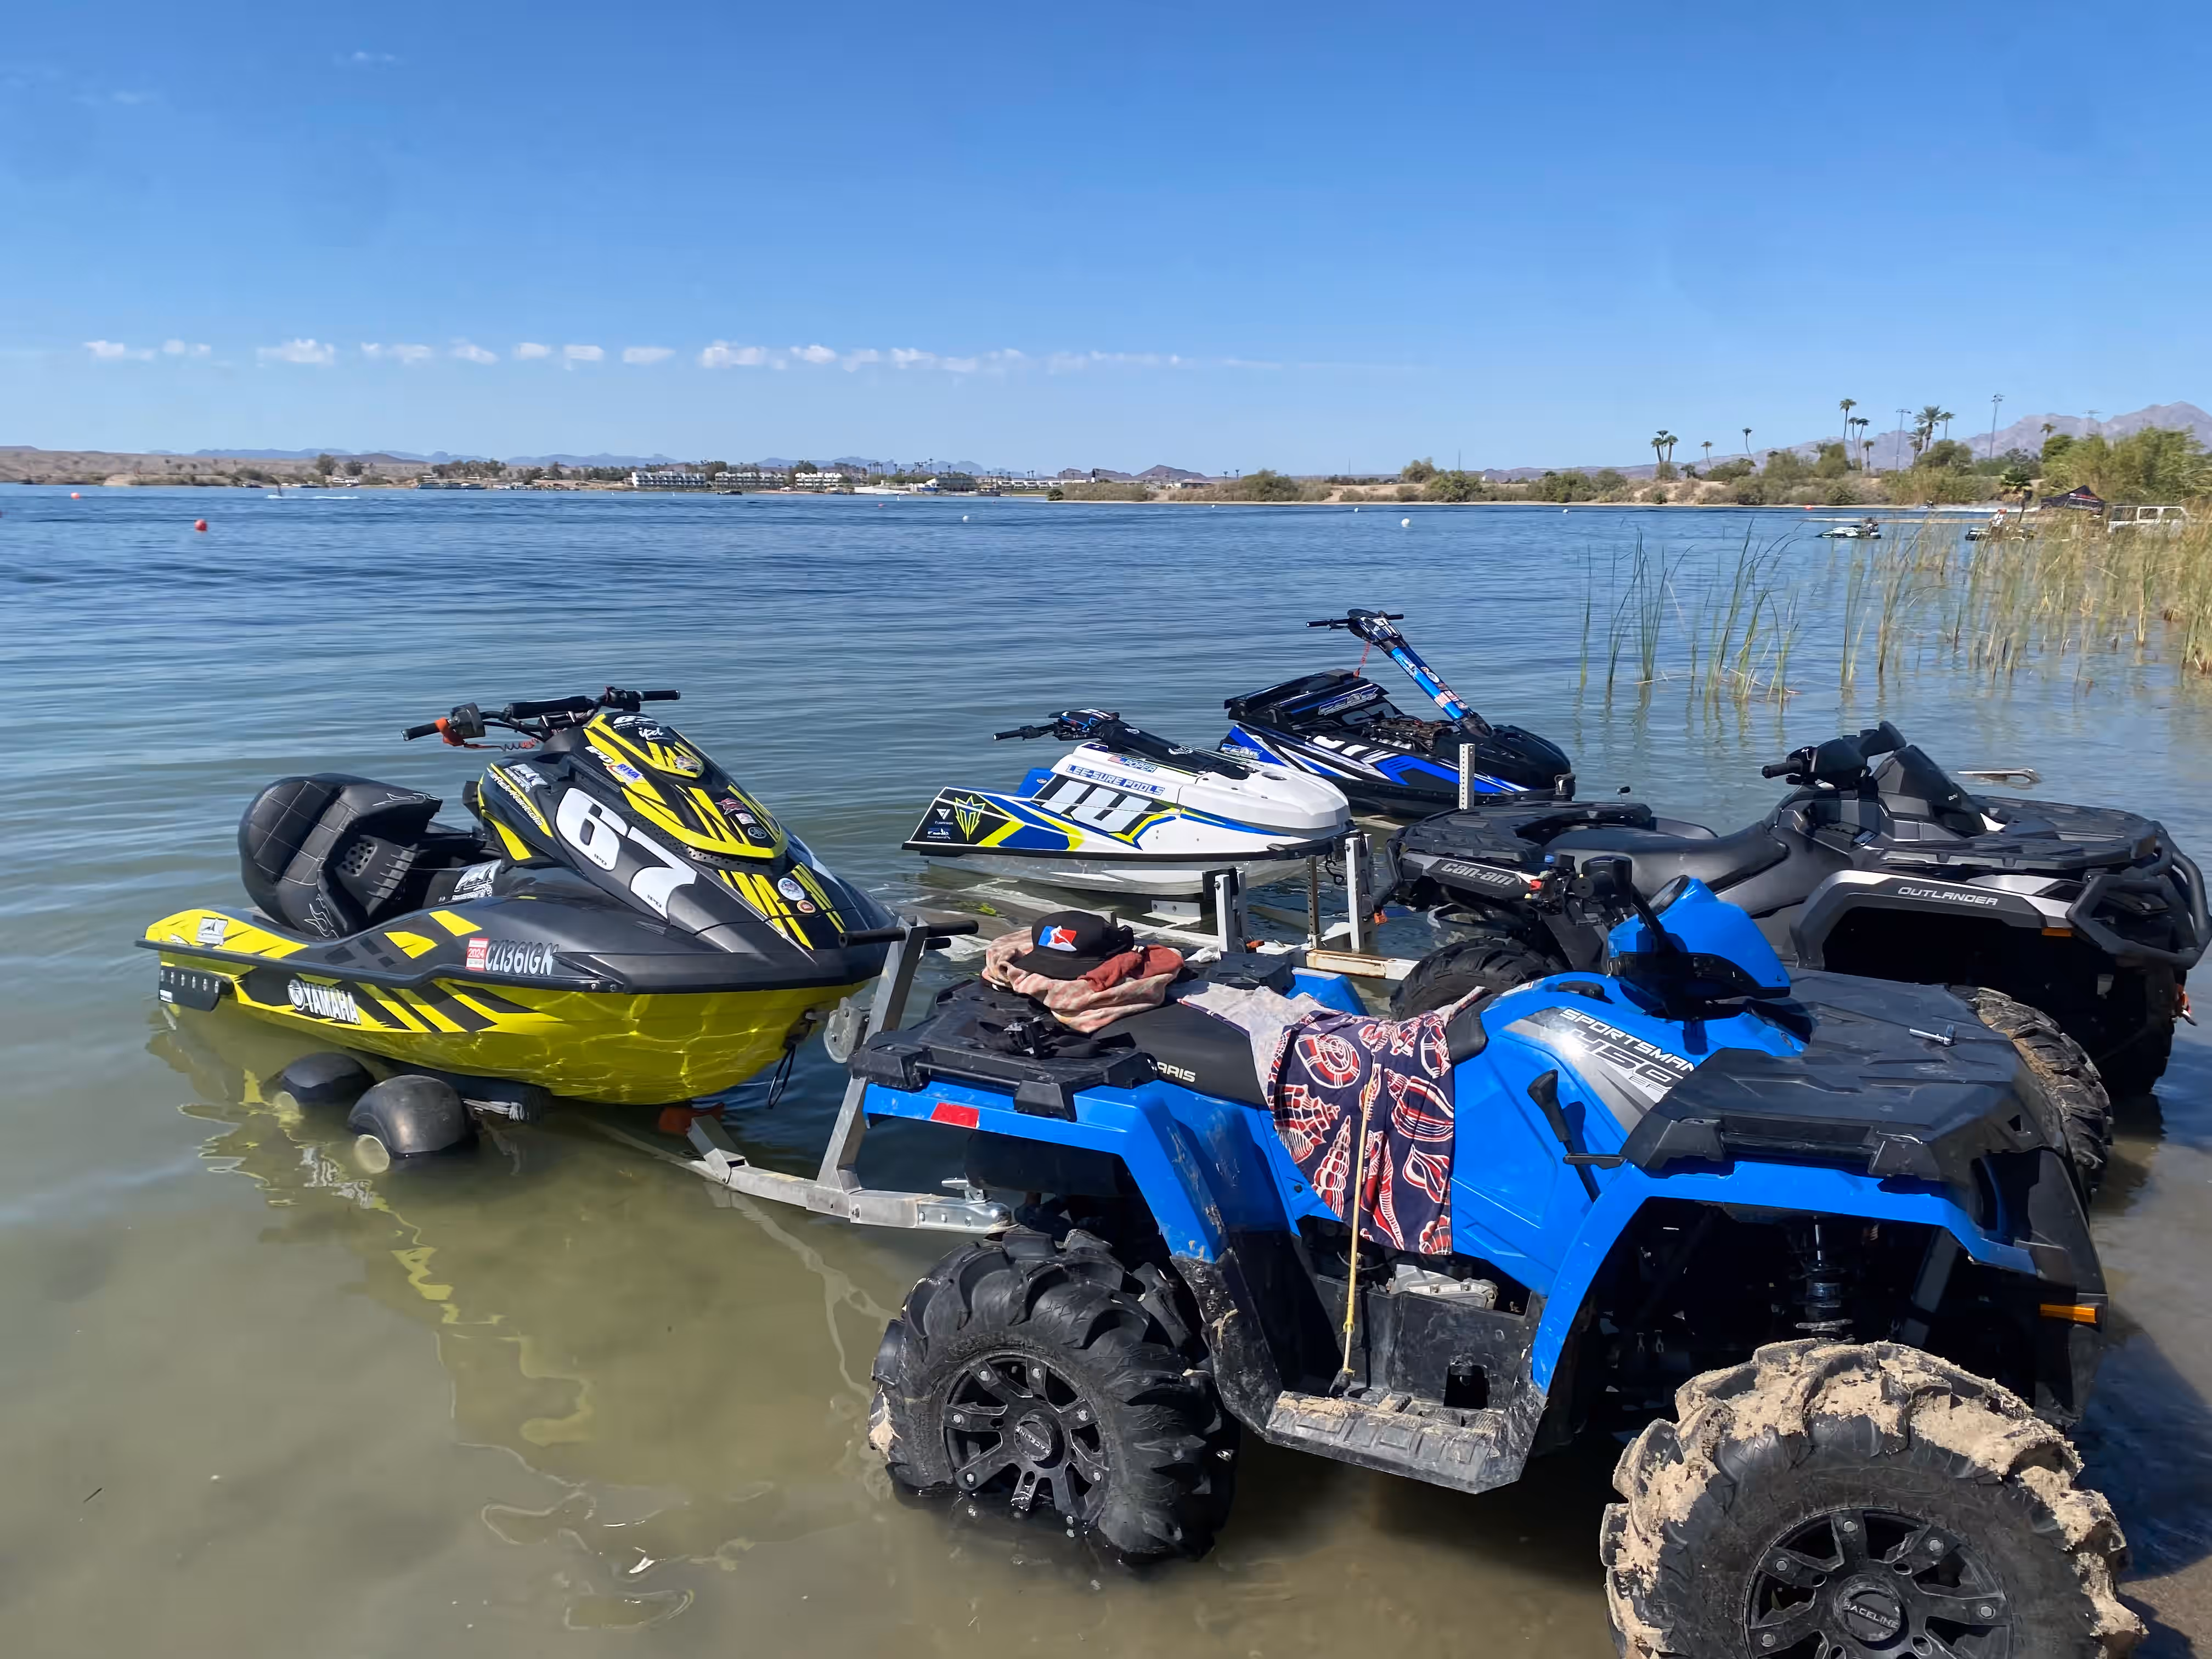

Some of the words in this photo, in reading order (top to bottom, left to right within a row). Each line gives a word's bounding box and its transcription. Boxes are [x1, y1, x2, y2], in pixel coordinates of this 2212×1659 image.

[617, 763, 641, 779] RIVA
[1066, 764, 1123, 785] LEE-SURE
[1123, 778, 1165, 795] POOLS
[556, 787, 697, 920] 67
[1441, 862, 1516, 885] can-am
[1898, 887, 1999, 906] OUTLANDER
[467, 949, 484, 958] 2024
[302, 981, 361, 1025] YAMAHA
[1559, 1008, 1695, 1072] SPORTSMAN
[1843, 1597, 1899, 1630] RACELINE
